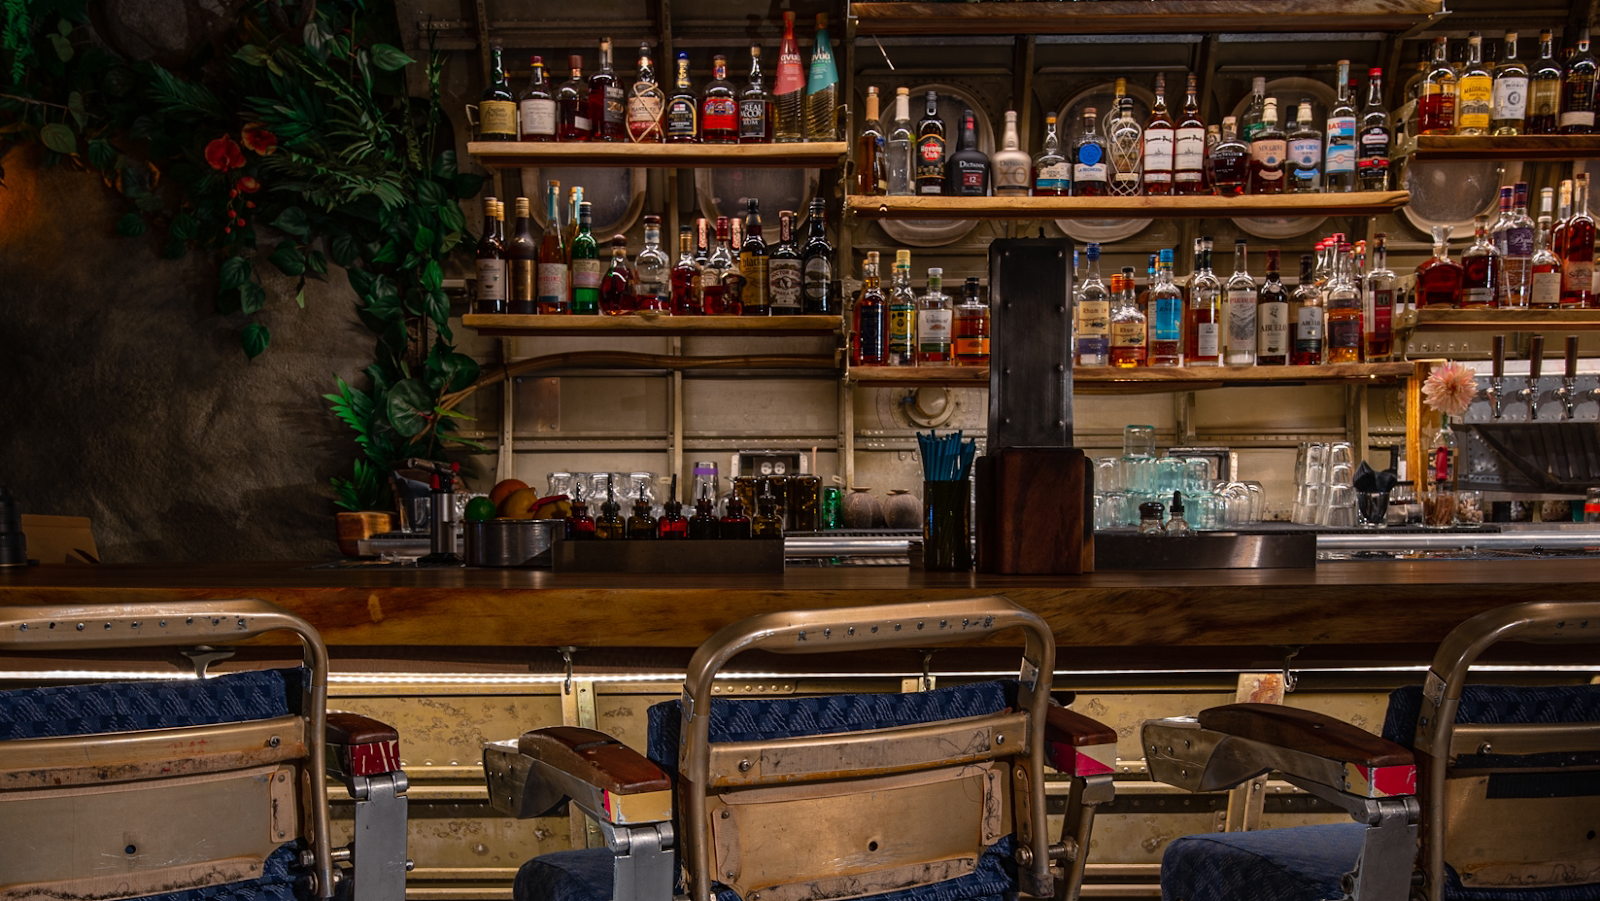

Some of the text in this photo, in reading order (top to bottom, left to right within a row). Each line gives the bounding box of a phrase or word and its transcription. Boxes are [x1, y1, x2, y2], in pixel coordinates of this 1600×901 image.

[920, 145, 943, 153] Havana
[997, 166, 1028, 185] XO
[1260, 324, 1287, 332] ABUELO
